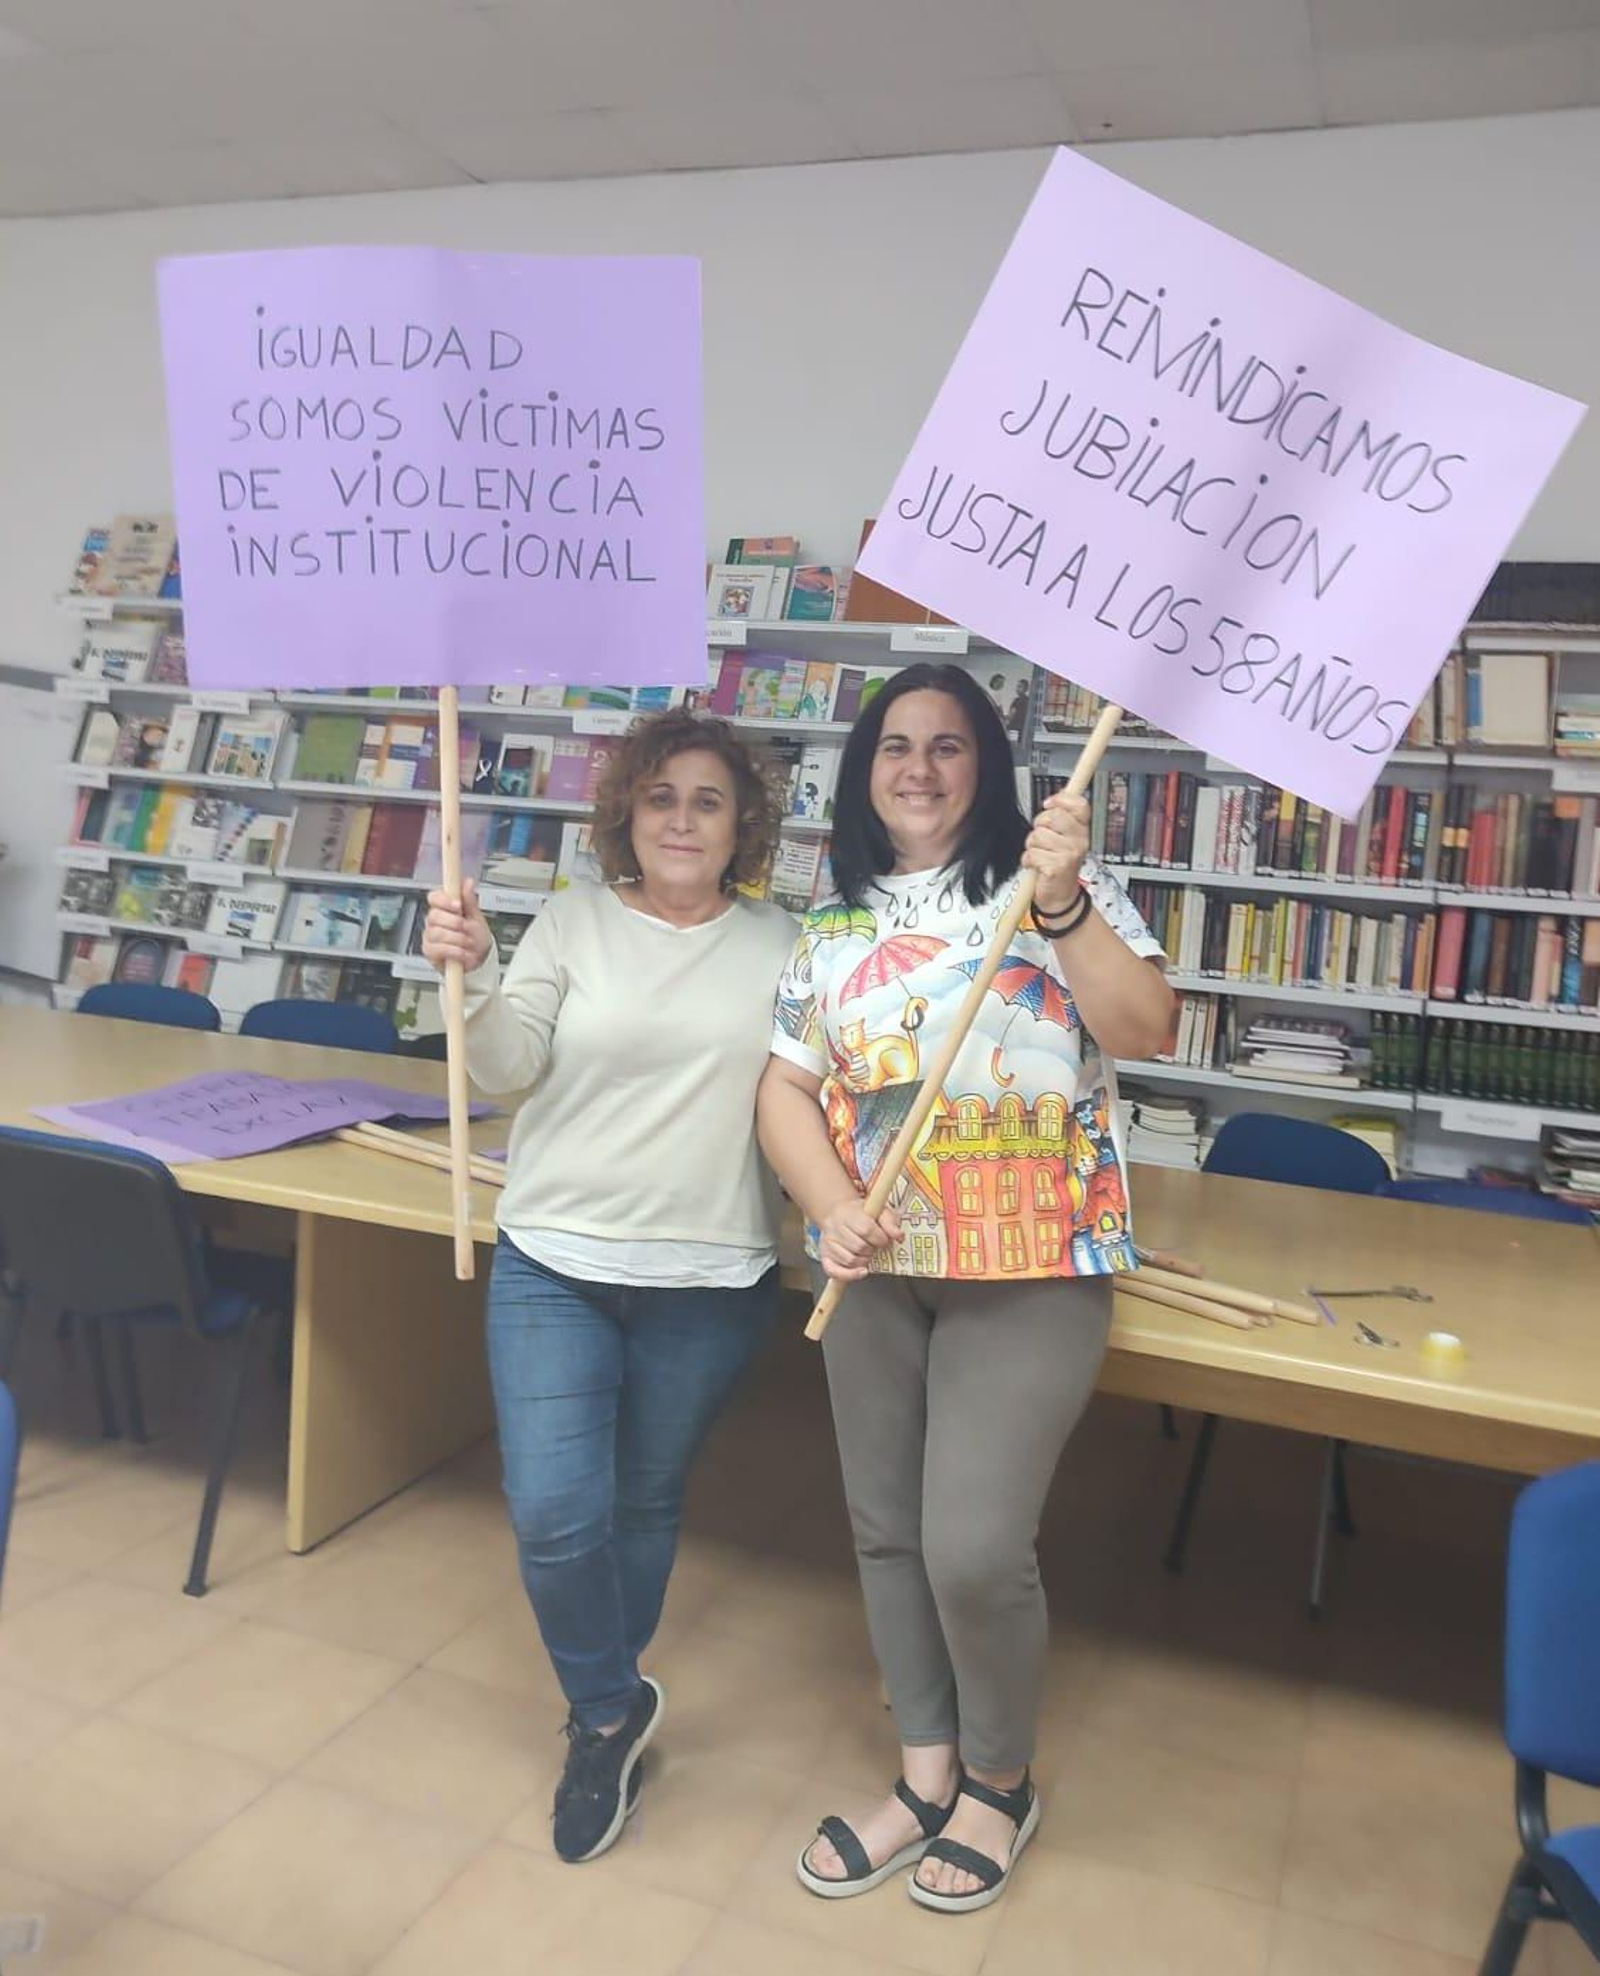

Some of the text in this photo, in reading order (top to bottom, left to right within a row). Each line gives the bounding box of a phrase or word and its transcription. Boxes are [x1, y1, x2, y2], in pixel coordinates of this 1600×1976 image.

[229, 397, 402, 442] SOMOS
[218, 469, 281, 511] DE
[898, 466, 1046, 587] JUSTA
[1044, 543, 1089, 609] A
[1094, 563, 1202, 655] LOS
